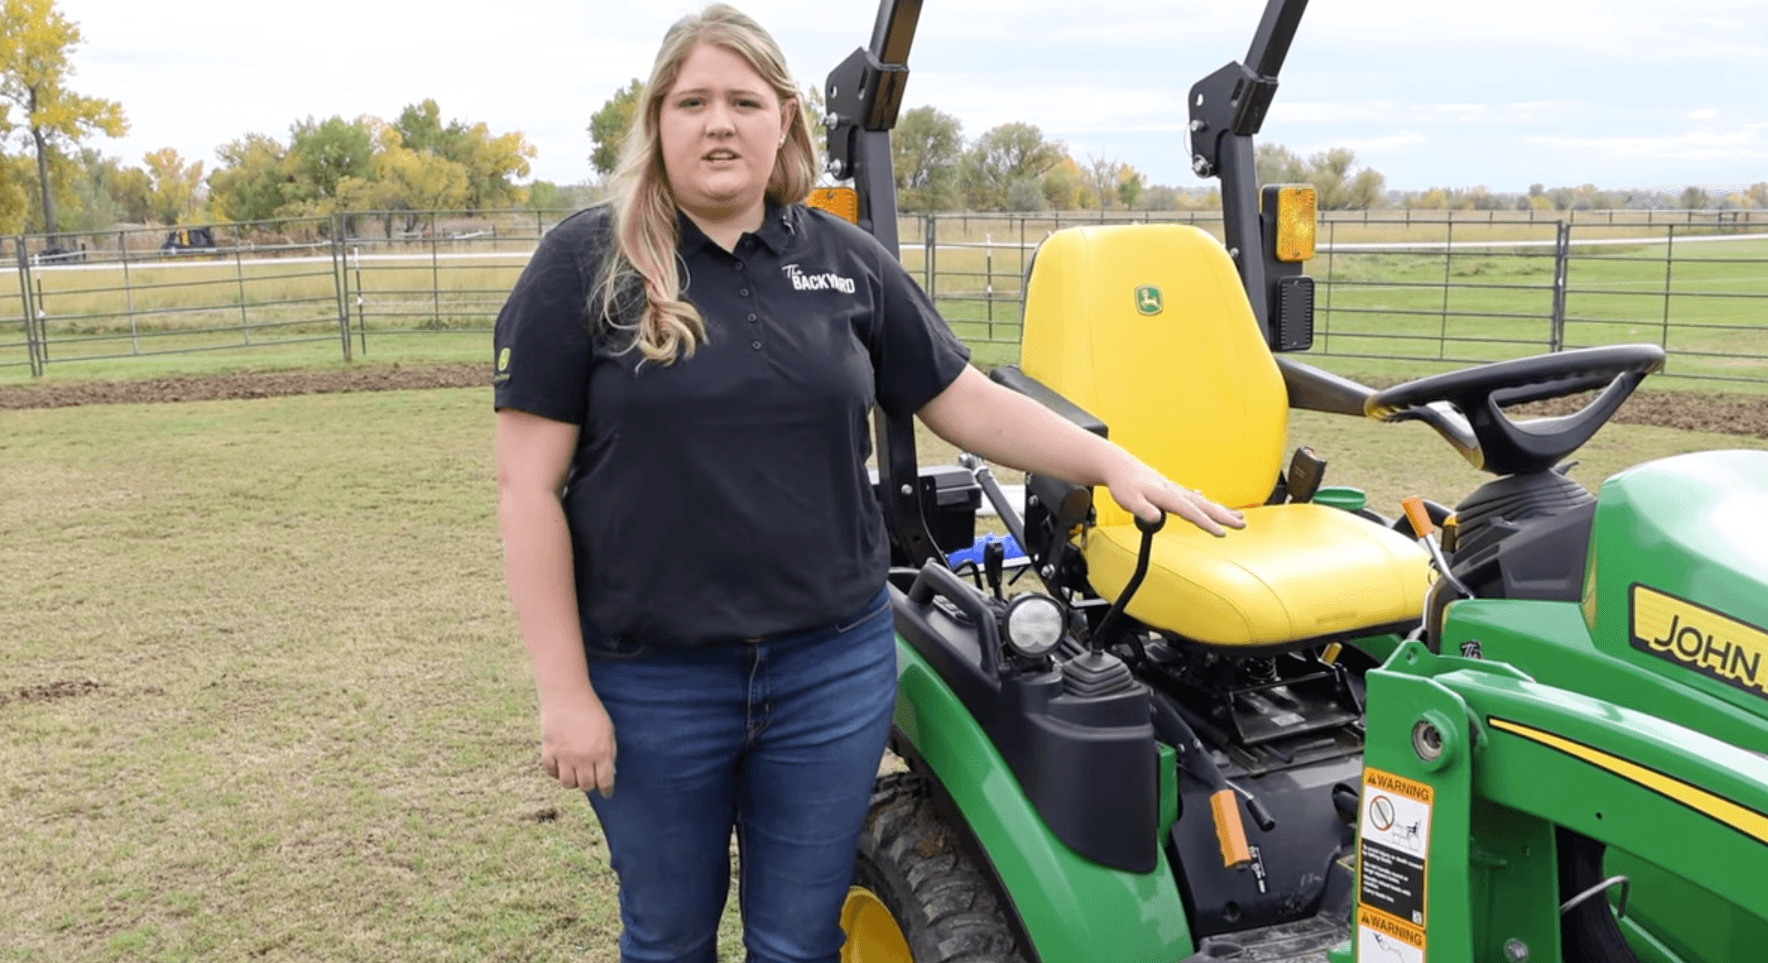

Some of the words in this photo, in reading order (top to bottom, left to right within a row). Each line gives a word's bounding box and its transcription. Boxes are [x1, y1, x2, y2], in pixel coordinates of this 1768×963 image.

[792, 273, 855, 293] BACKYARD
[1653, 614, 1761, 682] JOHN
[1375, 774, 1430, 801] WARNING
[1370, 915, 1423, 946] WARNING
